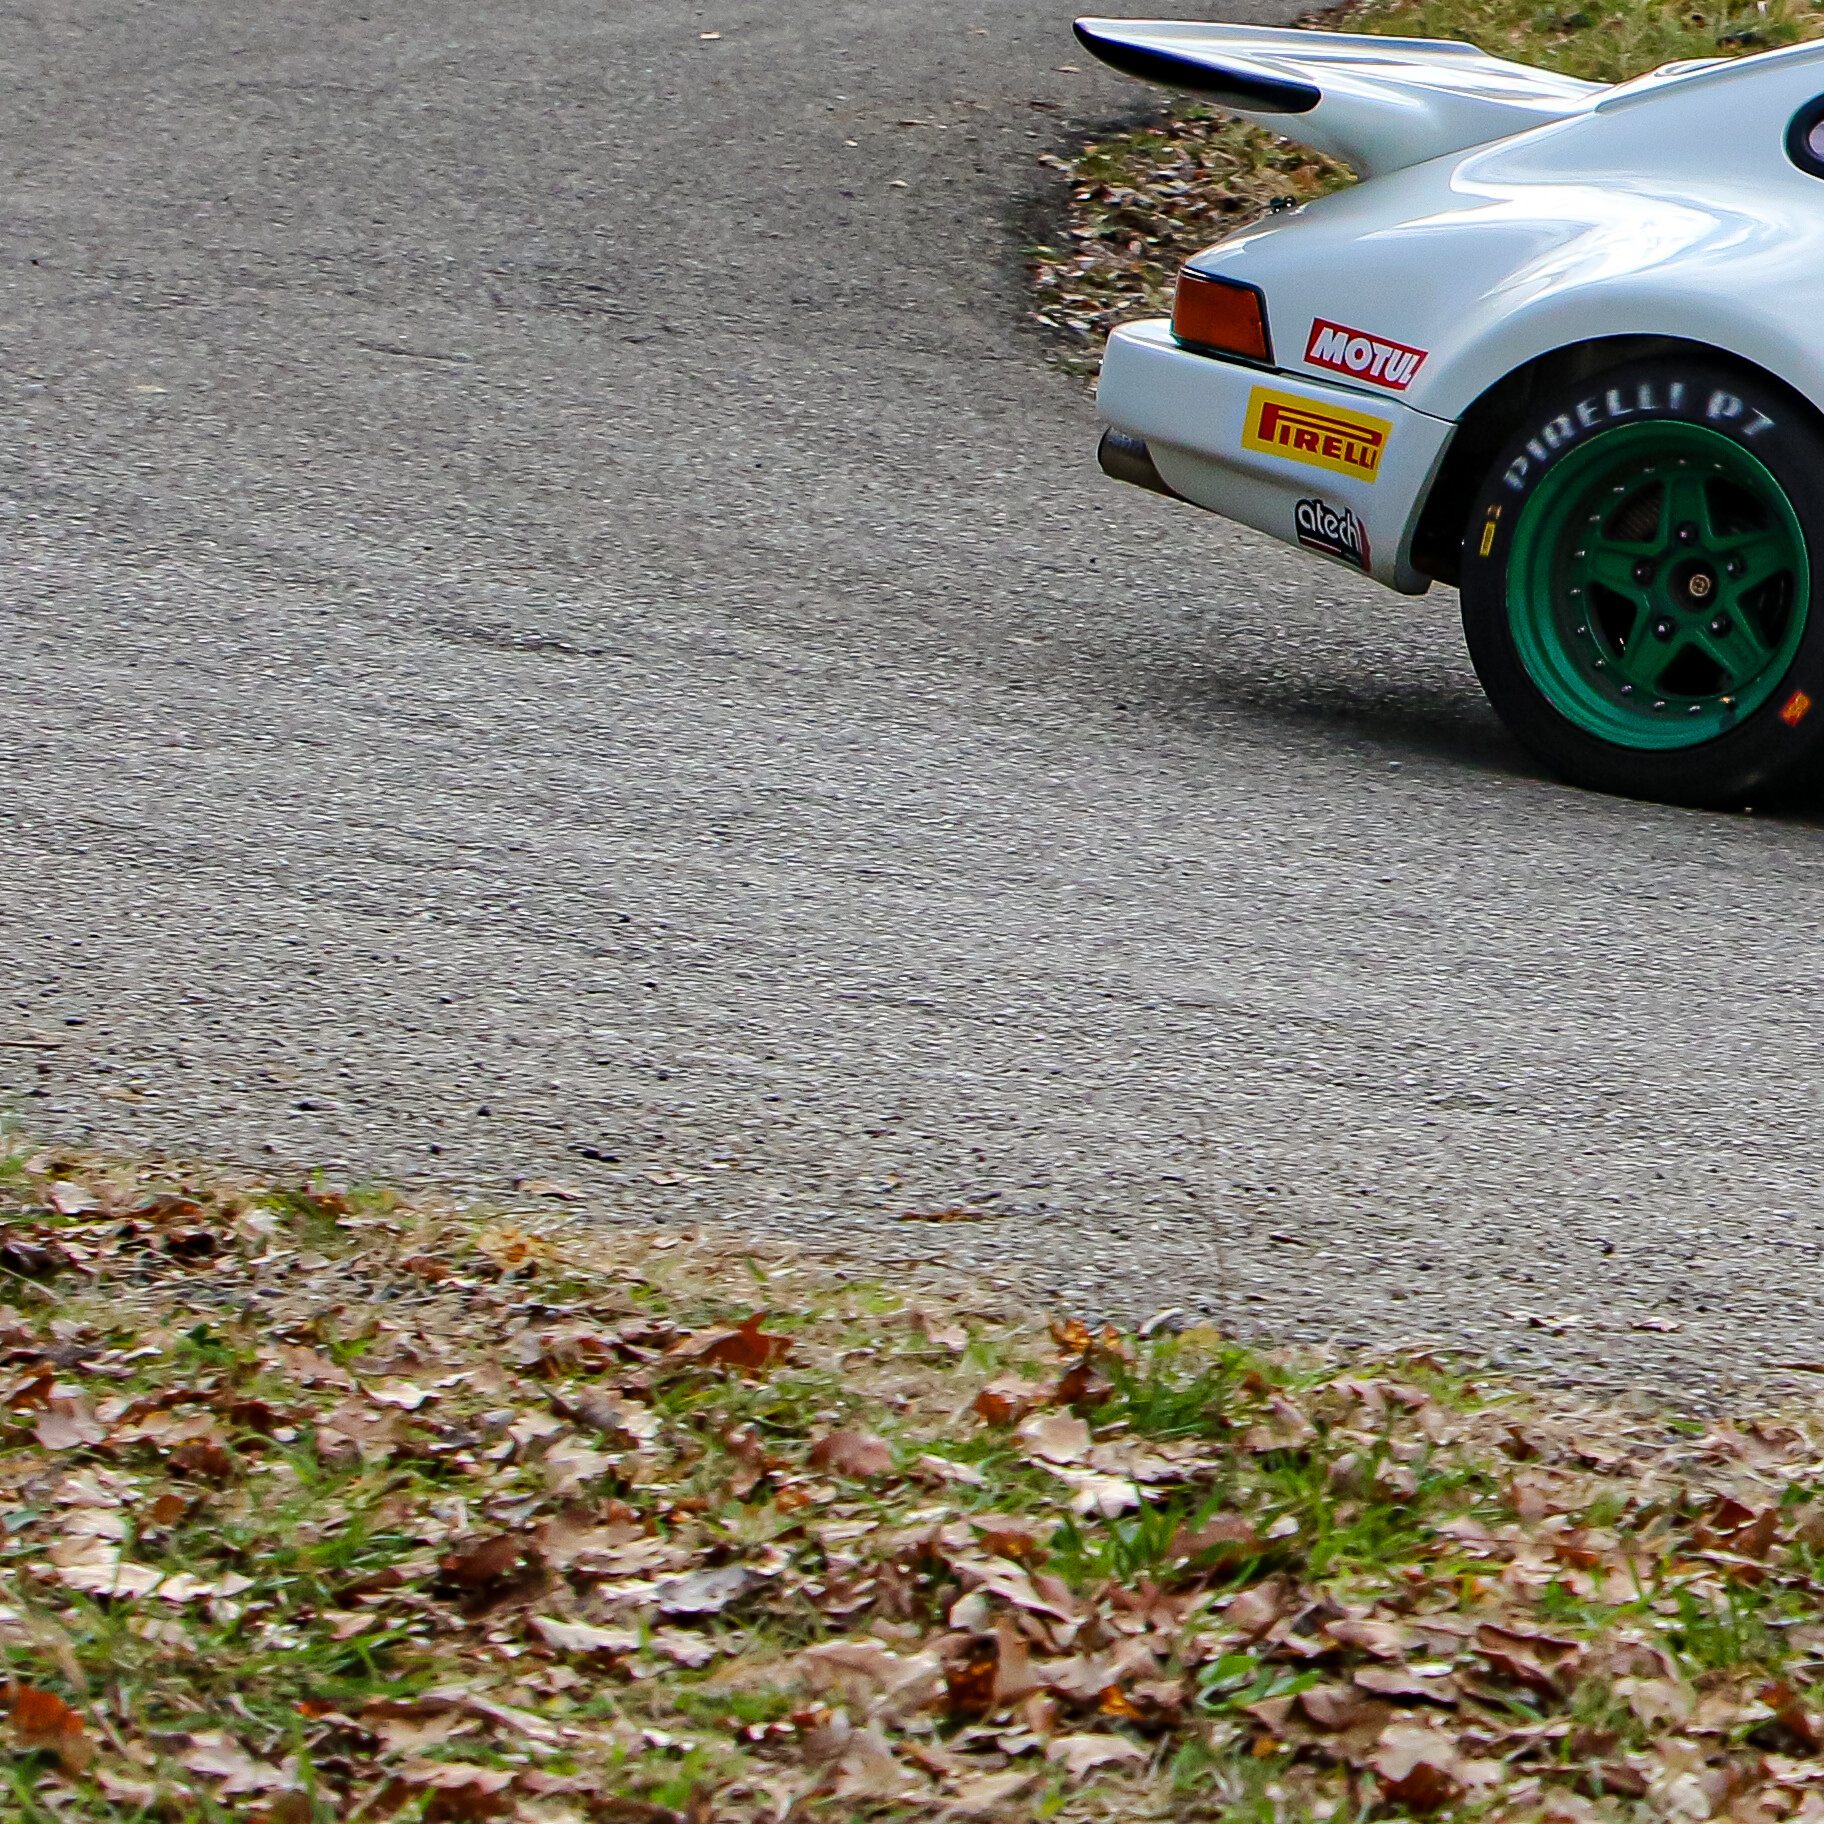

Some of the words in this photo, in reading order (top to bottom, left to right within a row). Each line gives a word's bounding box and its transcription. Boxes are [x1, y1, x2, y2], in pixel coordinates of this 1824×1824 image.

[1310, 326, 1421, 384] MOTUL
[1257, 401, 1383, 471] PIRELLI
[1503, 381, 1685, 492] PIRELLI
[1298, 503, 1362, 554] atech
